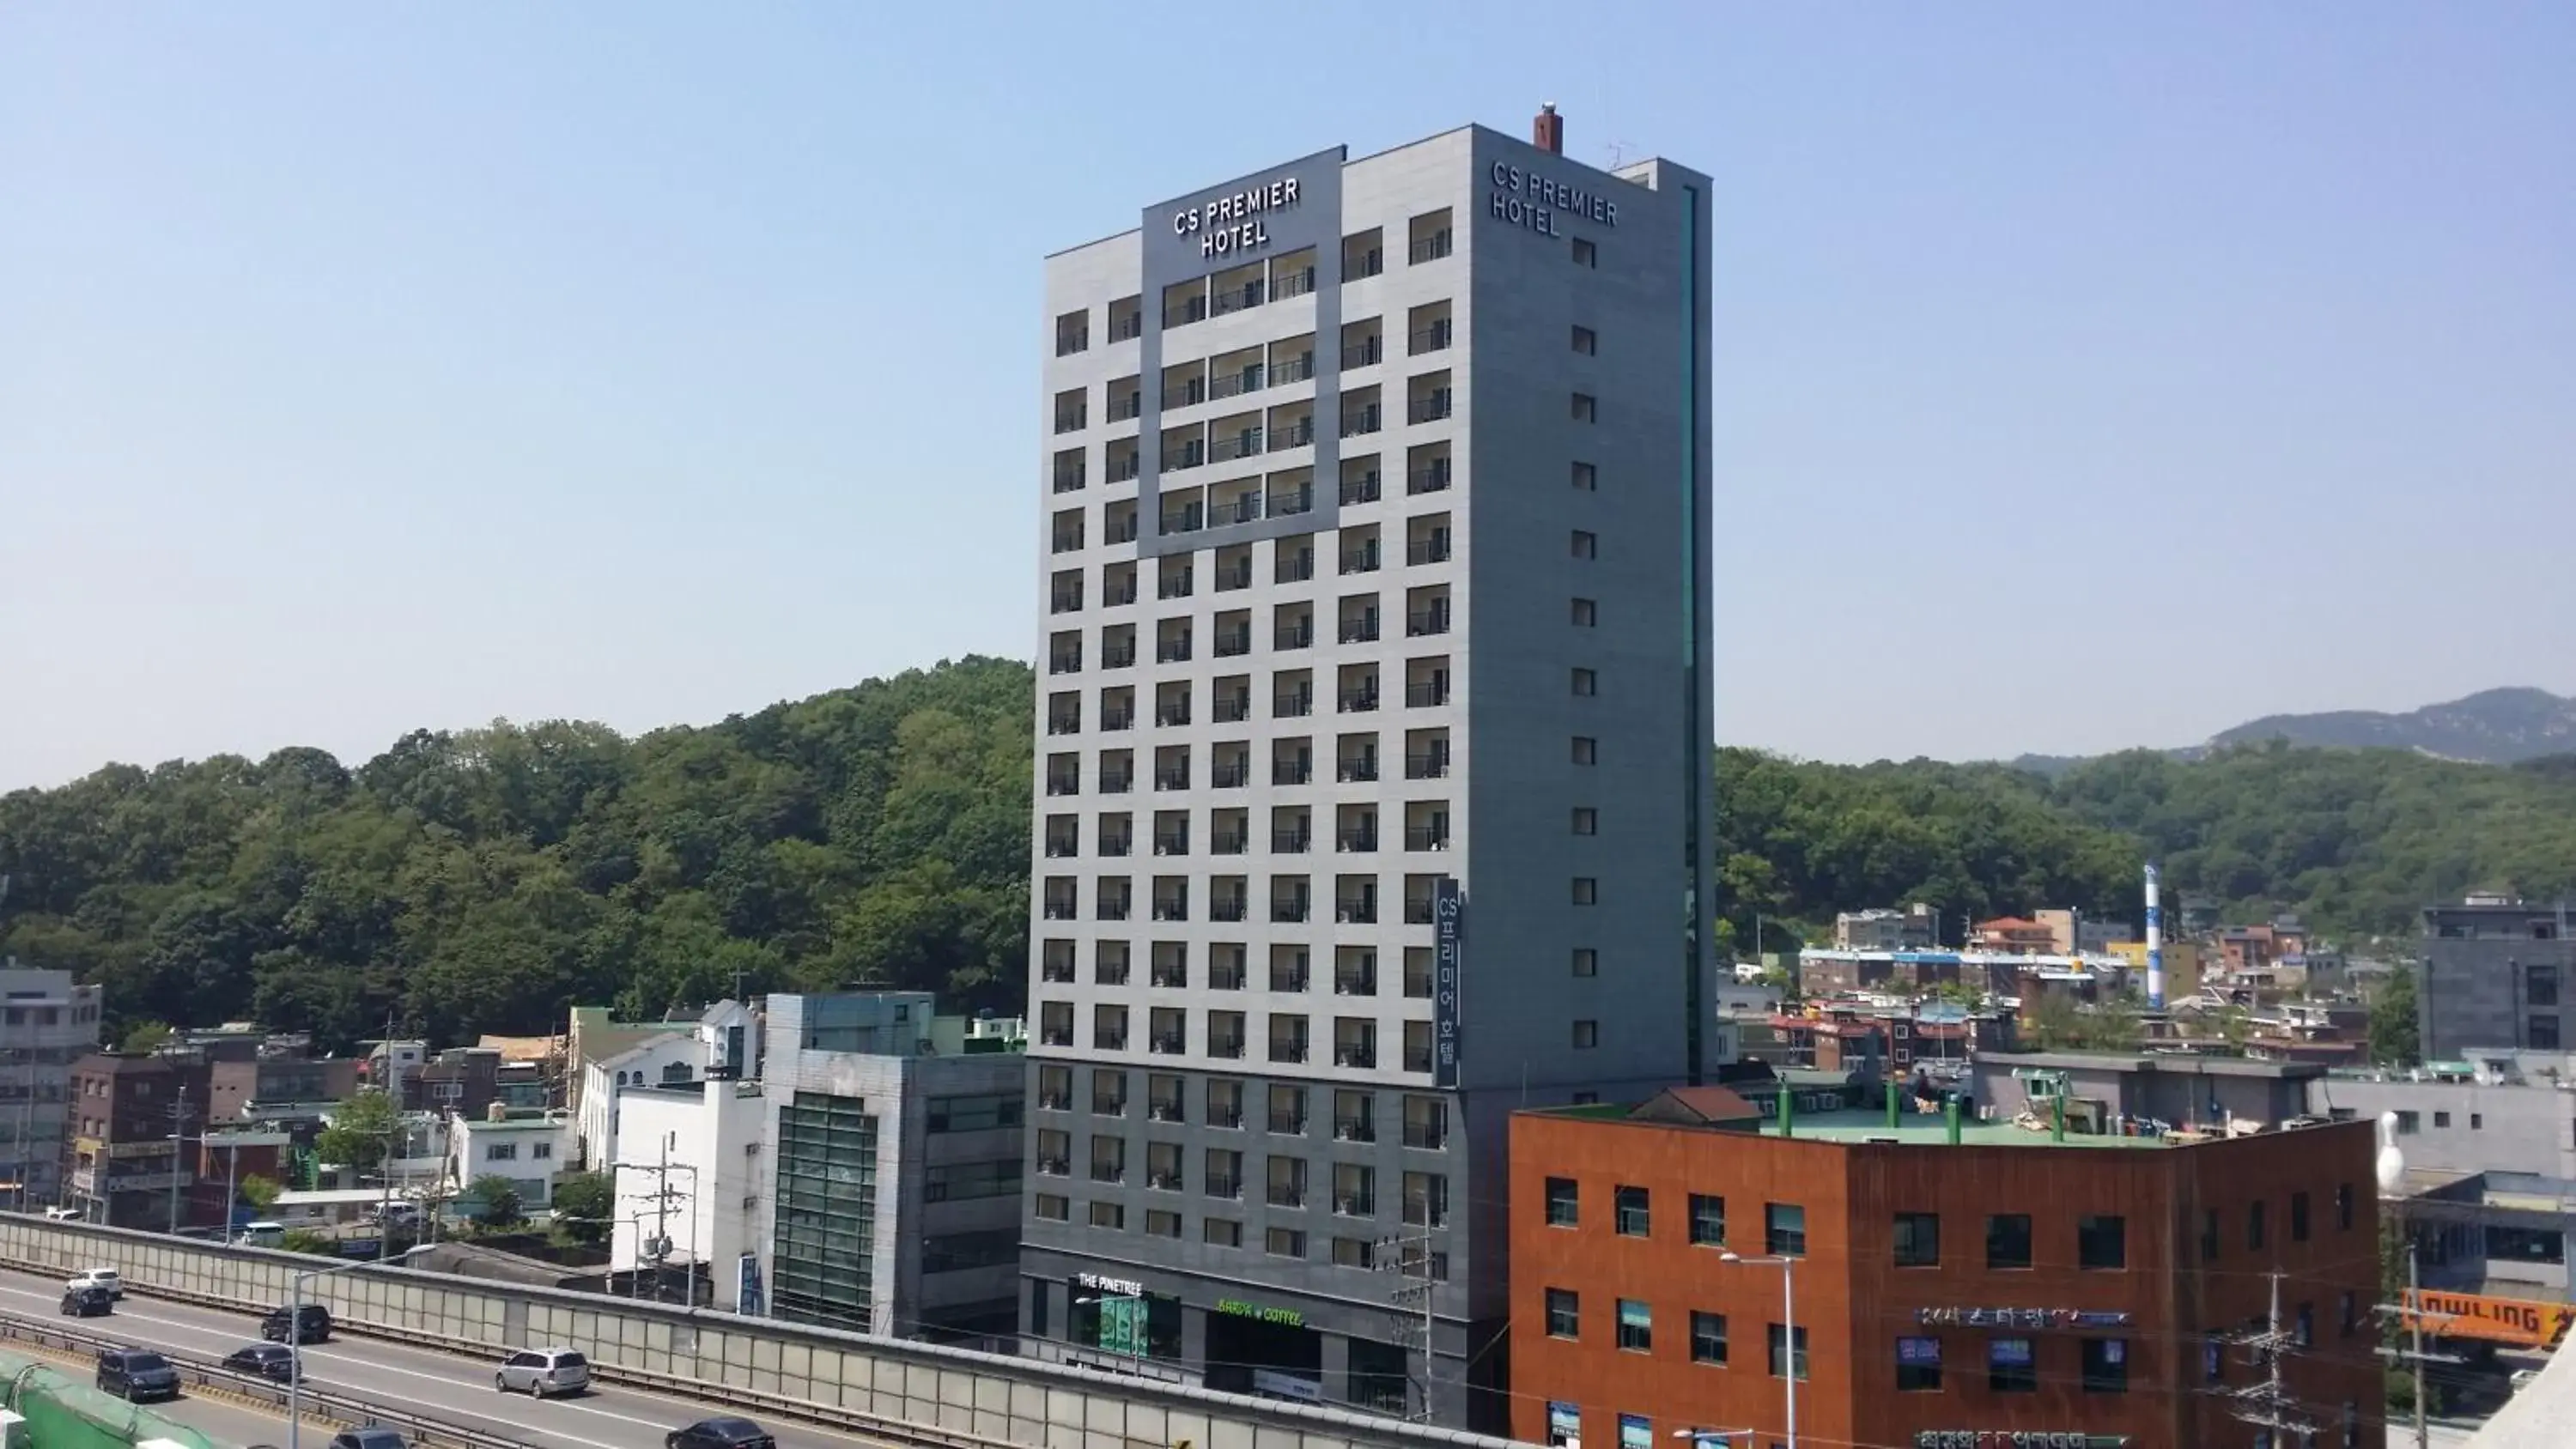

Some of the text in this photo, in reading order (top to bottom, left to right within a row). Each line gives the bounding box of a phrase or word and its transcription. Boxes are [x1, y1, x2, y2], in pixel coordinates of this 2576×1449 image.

[1174, 178, 1299, 235] CS PREMIER
[1492, 161, 1619, 227] CS PREMIER
[1492, 191, 1562, 238] HOTEL
[1201, 220, 1269, 258] HOTEL
[1438, 898, 1457, 918] CS
[1441, 921, 1455, 1013] 프리미어
[1078, 1273, 1144, 1297] THE PINETREE
